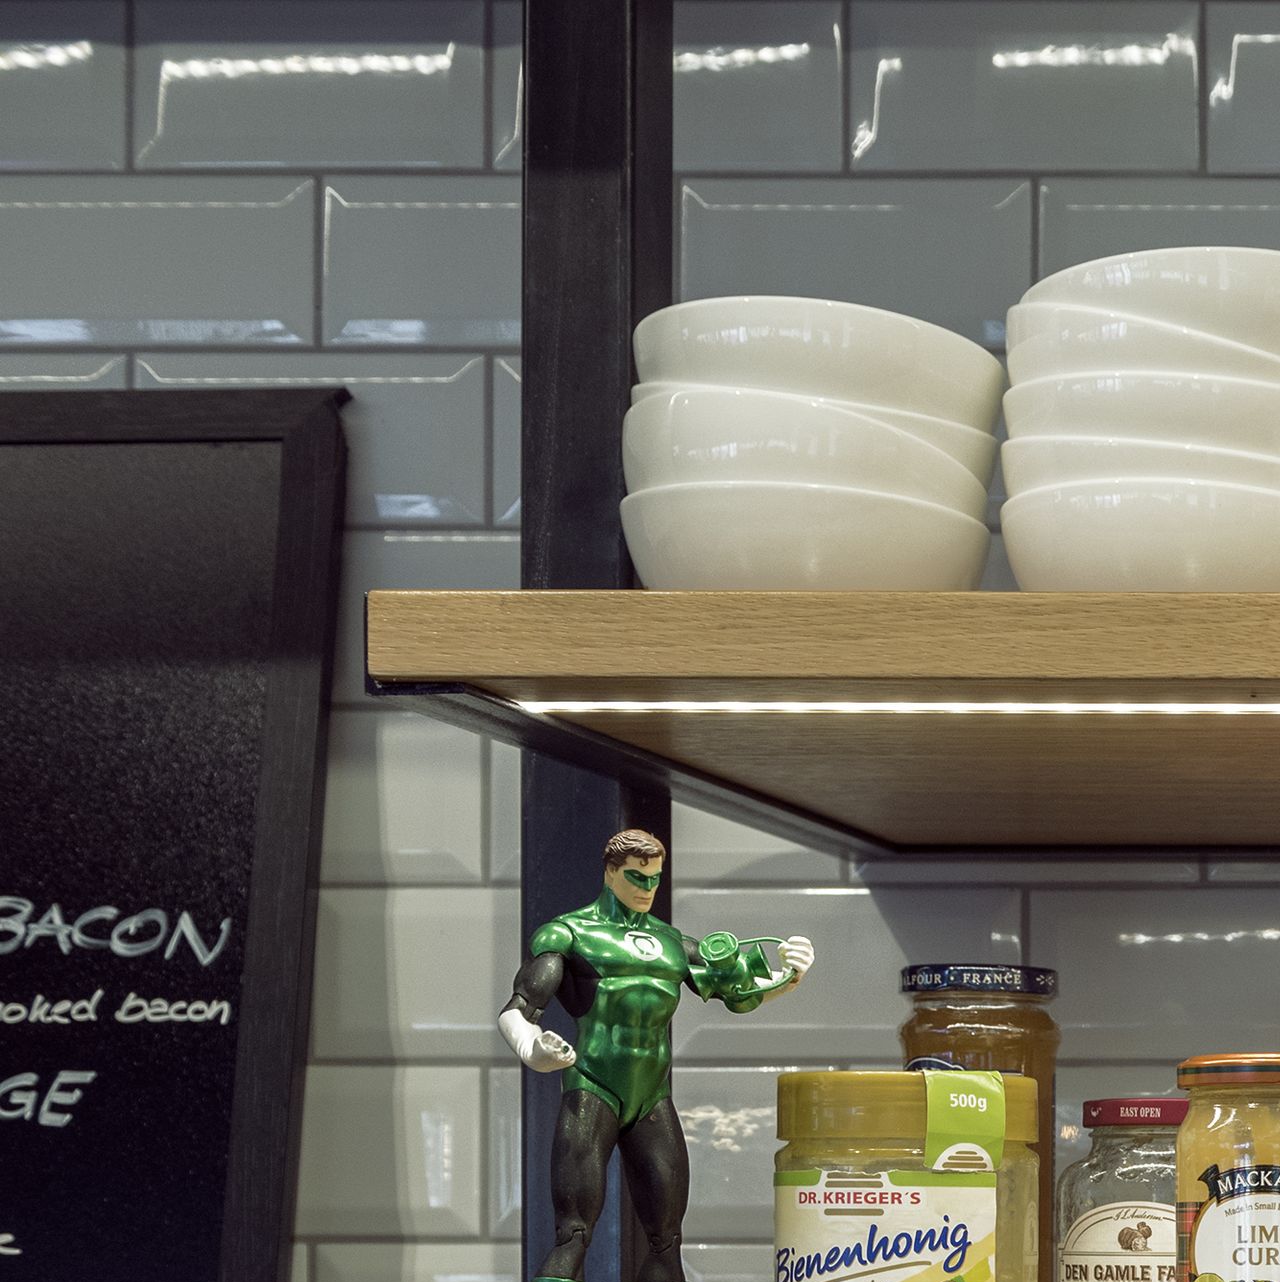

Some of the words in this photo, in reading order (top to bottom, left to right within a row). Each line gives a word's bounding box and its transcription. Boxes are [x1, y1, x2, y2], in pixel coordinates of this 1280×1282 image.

[963, 972, 1022, 986] FRANCE
[115, 992, 232, 1025] bacon
[949, 1092, 988, 1113] 500g
[1119, 1106, 1138, 1118] EASY
[1139, 1106, 1162, 1118] OPEN
[1224, 1204, 1244, 1219] Made
[1254, 1201, 1277, 1213] Small
[1065, 1264, 1089, 1281] DEN
[1093, 1264, 1152, 1282] GAMLE
[1156, 1264, 1177, 1282] FA
